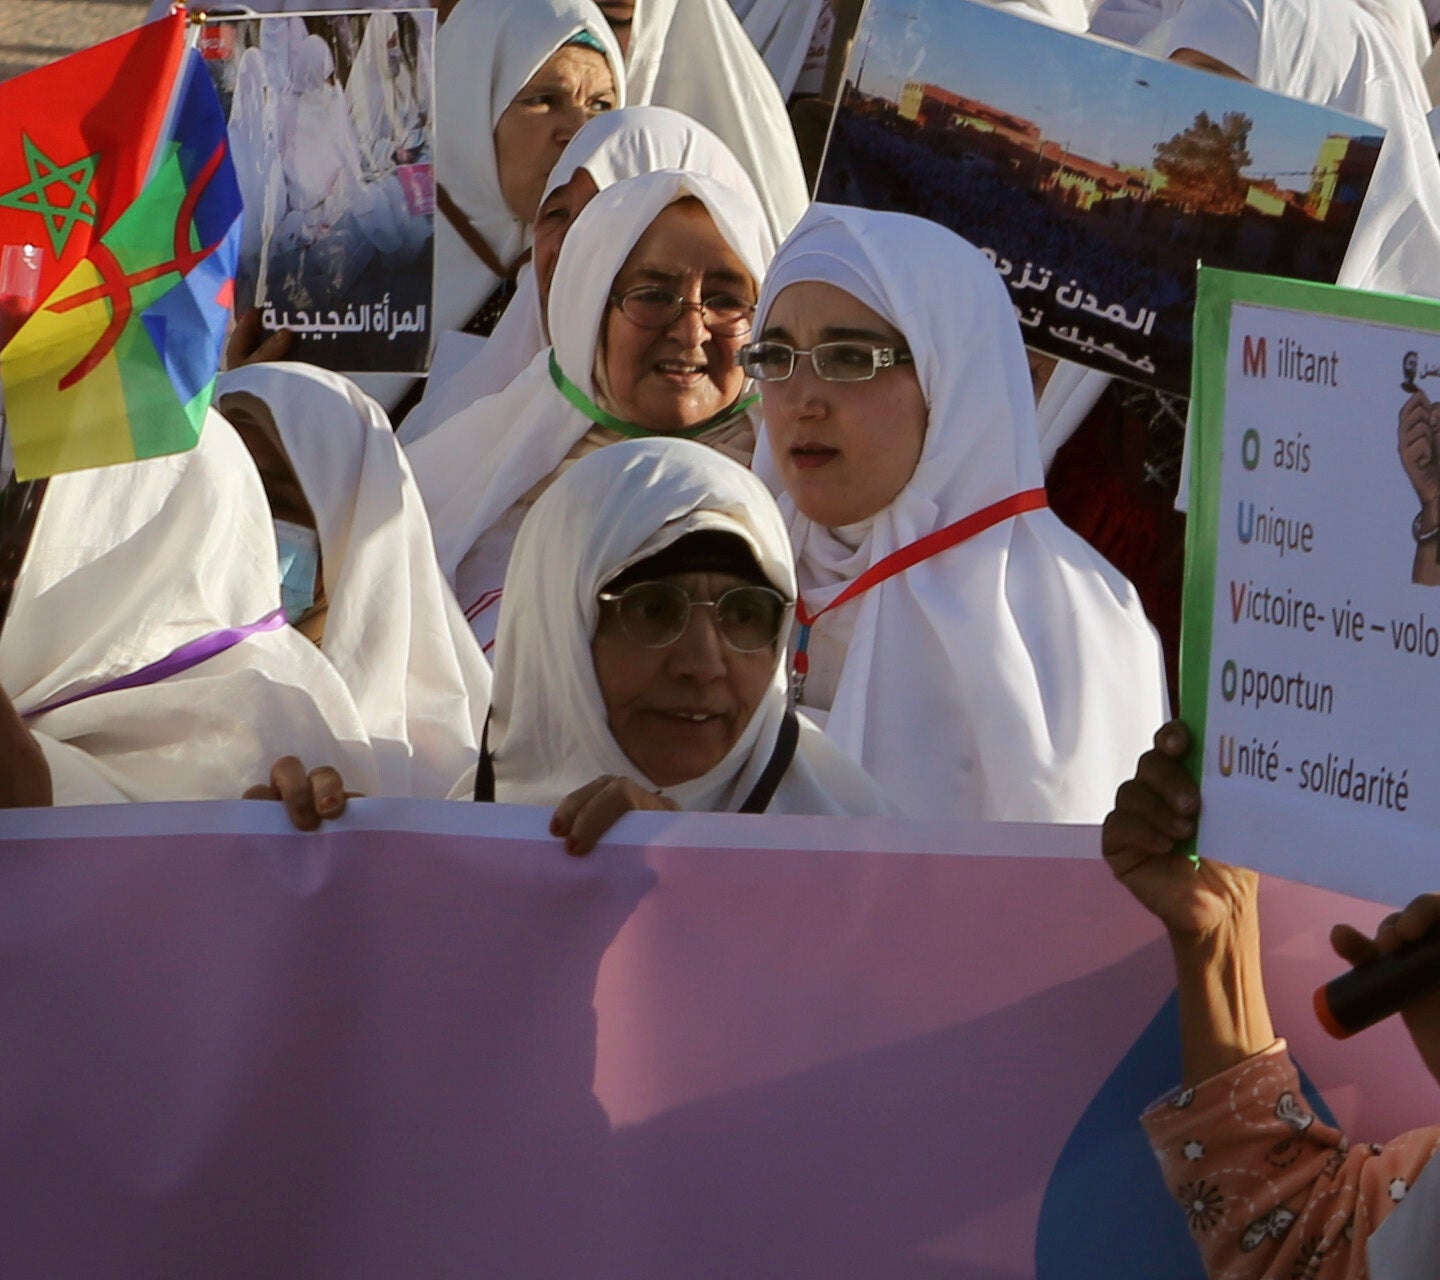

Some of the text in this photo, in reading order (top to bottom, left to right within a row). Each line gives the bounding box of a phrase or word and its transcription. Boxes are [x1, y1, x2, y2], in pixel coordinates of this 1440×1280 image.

[261, 292, 426, 341] المرأة الفجيجية
[1055, 279, 1157, 336] المدن
[1237, 500, 1314, 557] Unique
[1332, 600, 1365, 642] vie
[1299, 752, 1408, 812] solidarité
